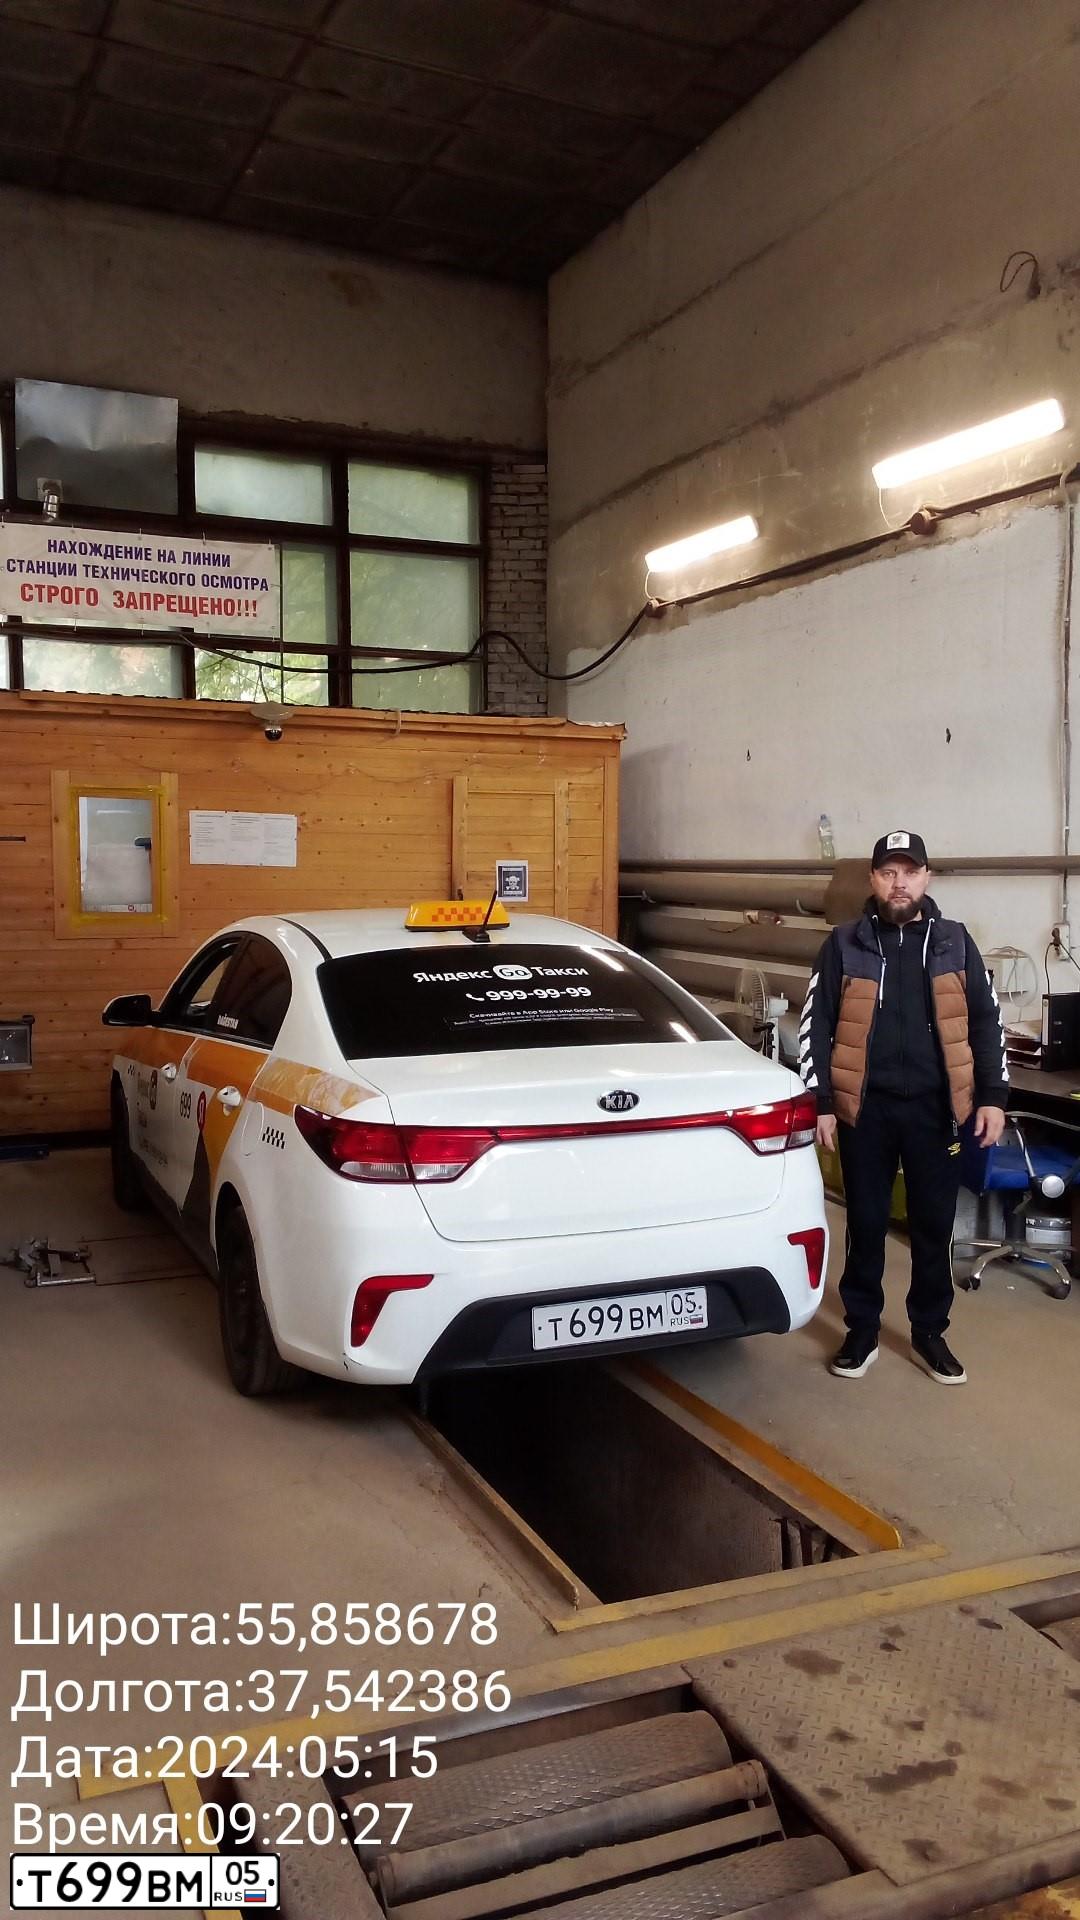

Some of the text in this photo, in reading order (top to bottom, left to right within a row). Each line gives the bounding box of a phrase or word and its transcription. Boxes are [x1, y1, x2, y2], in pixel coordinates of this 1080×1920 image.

[47, 539, 231, 568] НАХОЖДЕНИЕ НА ЛИНИИ
[6, 558, 269, 592] СТАНЦИИ ТЕХНИЧЕСКОГО ОСМОТРА
[20, 583, 257, 618] СТРОГО ЗАПРЕЩЕНО!!!
[412, 969, 493, 983] Яндекс
[531, 967, 589, 977] Такси
[485, 986, 592, 1001] 999-99-99
[180, 1091, 192, 1119] 699
[605, 1094, 634, 1109] KIA
[548, 1292, 697, 1341] Т699ВМ 05
[670, 1315, 690, 1327] RUS
